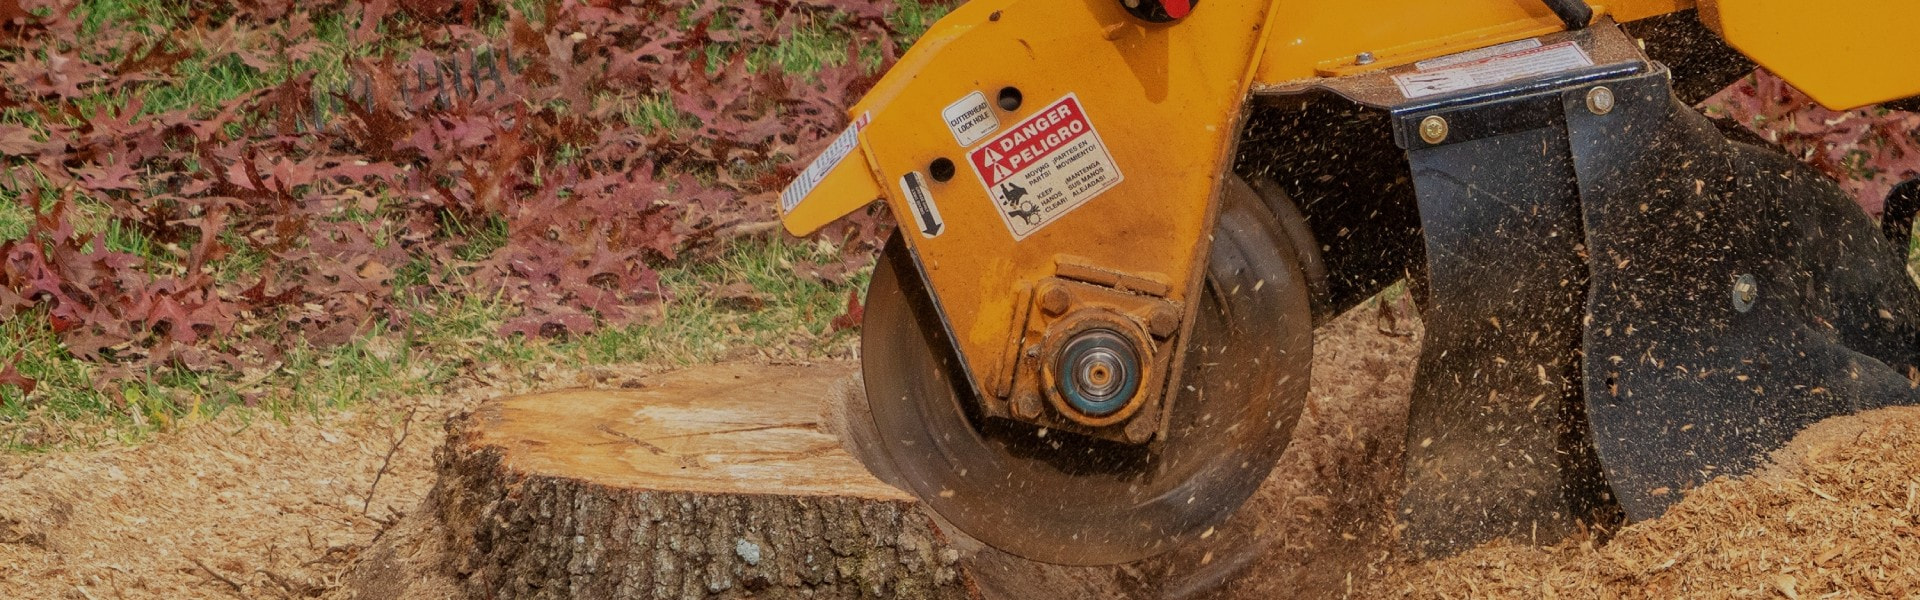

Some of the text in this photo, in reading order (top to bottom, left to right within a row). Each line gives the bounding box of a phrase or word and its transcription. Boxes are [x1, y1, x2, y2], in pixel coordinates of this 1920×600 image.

[950, 102, 988, 127] CUTTERHEAD
[957, 120, 975, 134] LOCK
[972, 111, 990, 125] HOLE
[1000, 104, 1072, 152] DANGER
[1009, 119, 1083, 169] PELIGRO
[1078, 139, 1089, 150] EN
[1055, 144, 1097, 171] MOVIMIENTO!
[1024, 162, 1050, 180] MOVING
[1028, 170, 1052, 187] PARTS!
[1067, 179, 1082, 191] SUS
[1080, 166, 1105, 183] MANOS
[1036, 187, 1054, 200] KEEP
[1072, 174, 1107, 198] ALEJADAS!
[1040, 190, 1063, 207] HANDS
[1044, 196, 1069, 214] CLEAR!
